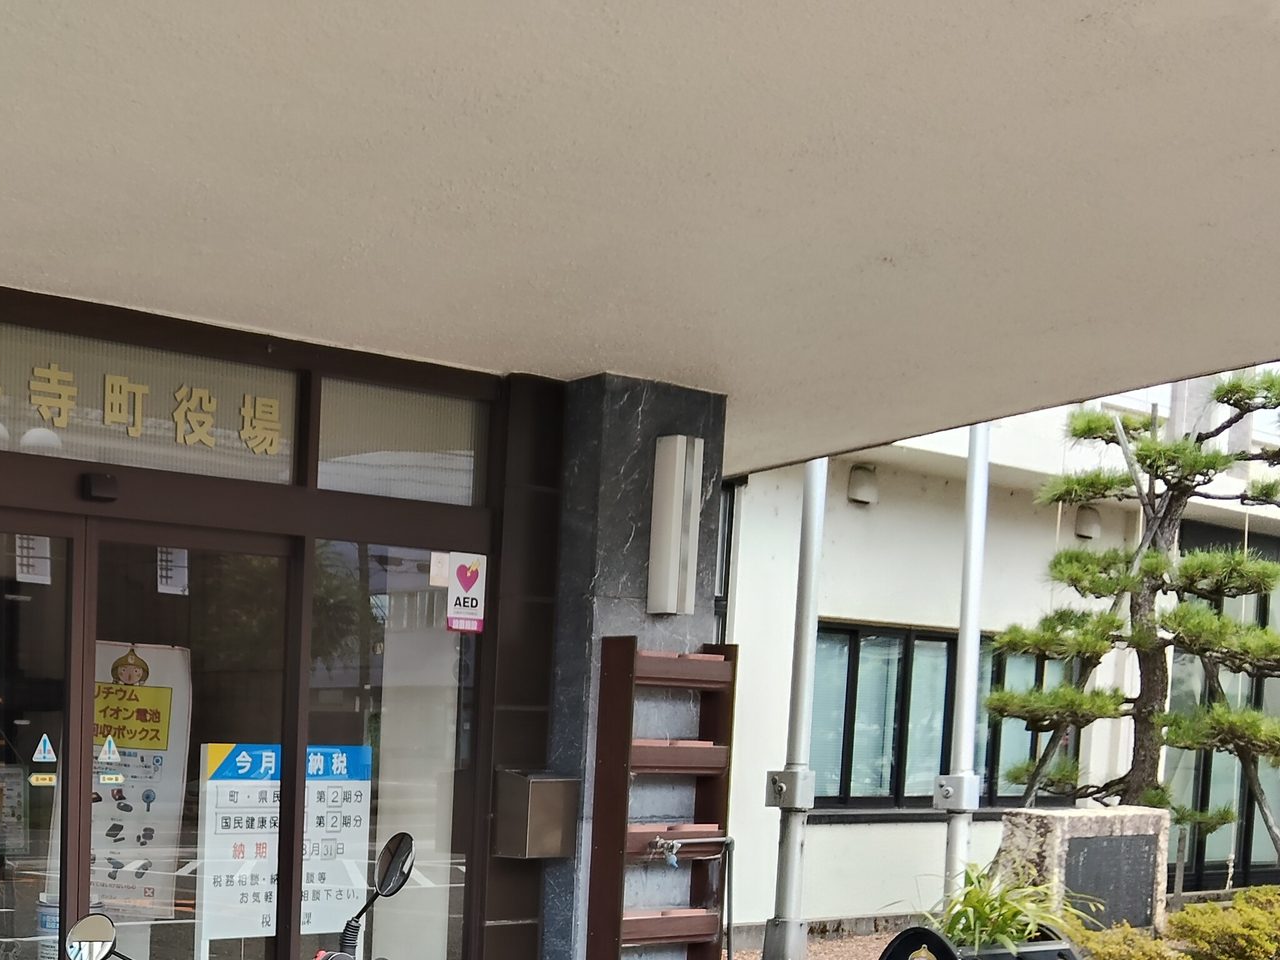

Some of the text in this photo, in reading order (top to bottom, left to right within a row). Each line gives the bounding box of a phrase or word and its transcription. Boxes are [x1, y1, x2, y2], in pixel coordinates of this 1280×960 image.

[454, 596, 478, 608] AED
[98, 705, 160, 723] イオン電池
[228, 790, 363, 803] 町・県民 第2期分
[221, 815, 363, 830] 国民健康保 第2期分
[232, 842, 268, 859] 納期
